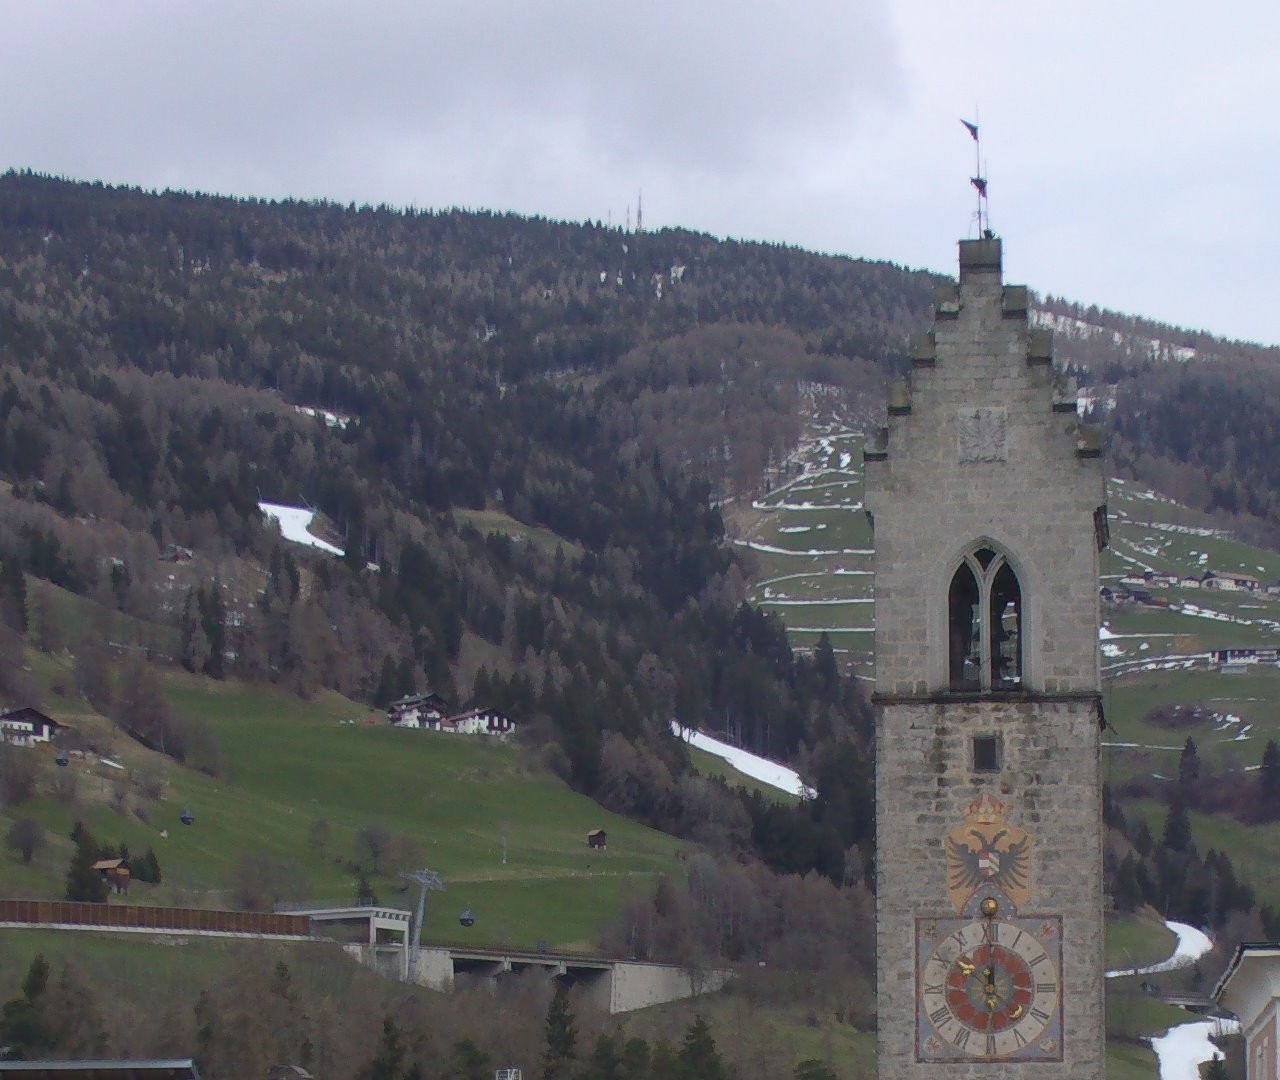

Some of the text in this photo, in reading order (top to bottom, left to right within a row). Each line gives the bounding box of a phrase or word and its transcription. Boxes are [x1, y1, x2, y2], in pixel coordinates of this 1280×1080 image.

[951, 929, 968, 952] XI
[980, 923, 999, 943] XII
[1011, 930, 1022, 949] I
[1029, 952, 1048, 968] II
[924, 983, 943, 994] IX
[1037, 983, 1056, 993] III
[929, 1004, 953, 1029] VIII
[953, 1028, 971, 1050] VII
[1013, 1028, 1027, 1048] V
